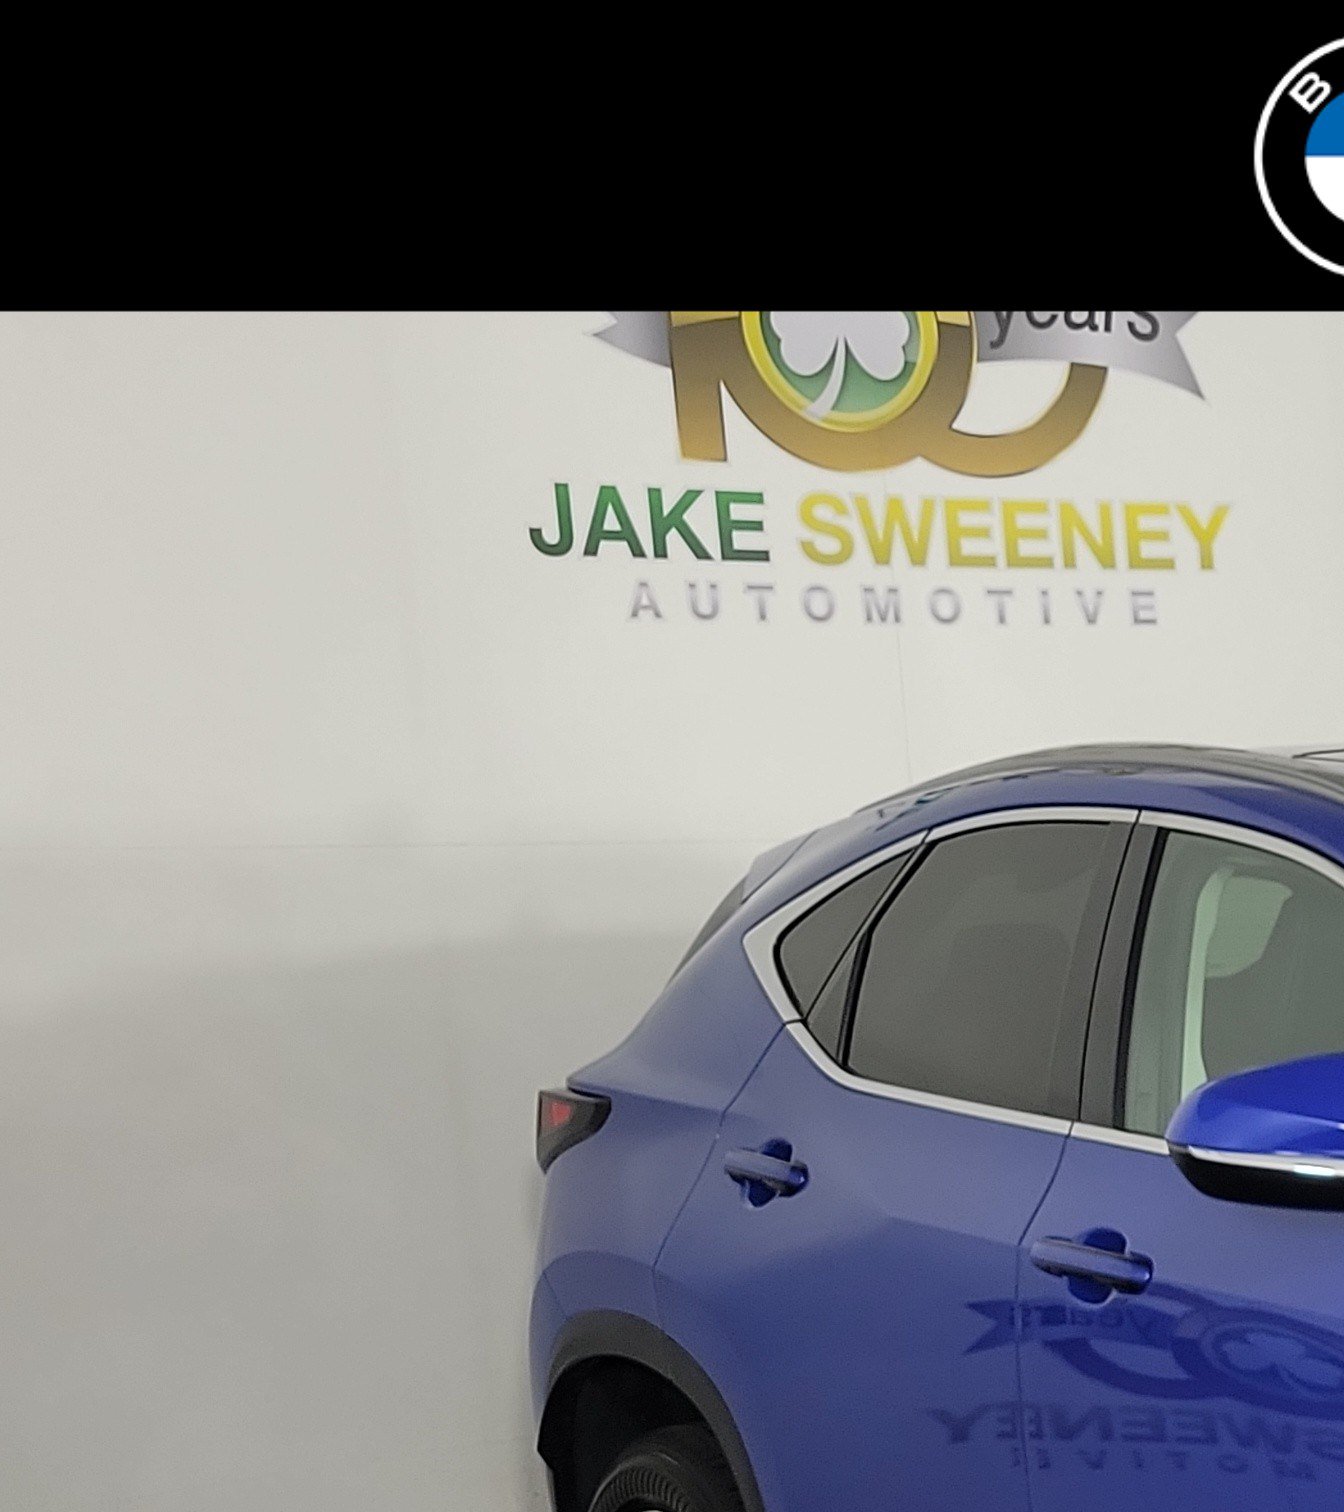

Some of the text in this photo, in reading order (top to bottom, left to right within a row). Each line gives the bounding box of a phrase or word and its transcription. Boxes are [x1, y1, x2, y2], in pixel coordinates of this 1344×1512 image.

[528, 482, 1232, 570] JAKE SWEENEY
[628, 581, 1159, 626] AUTOMOTIVE
